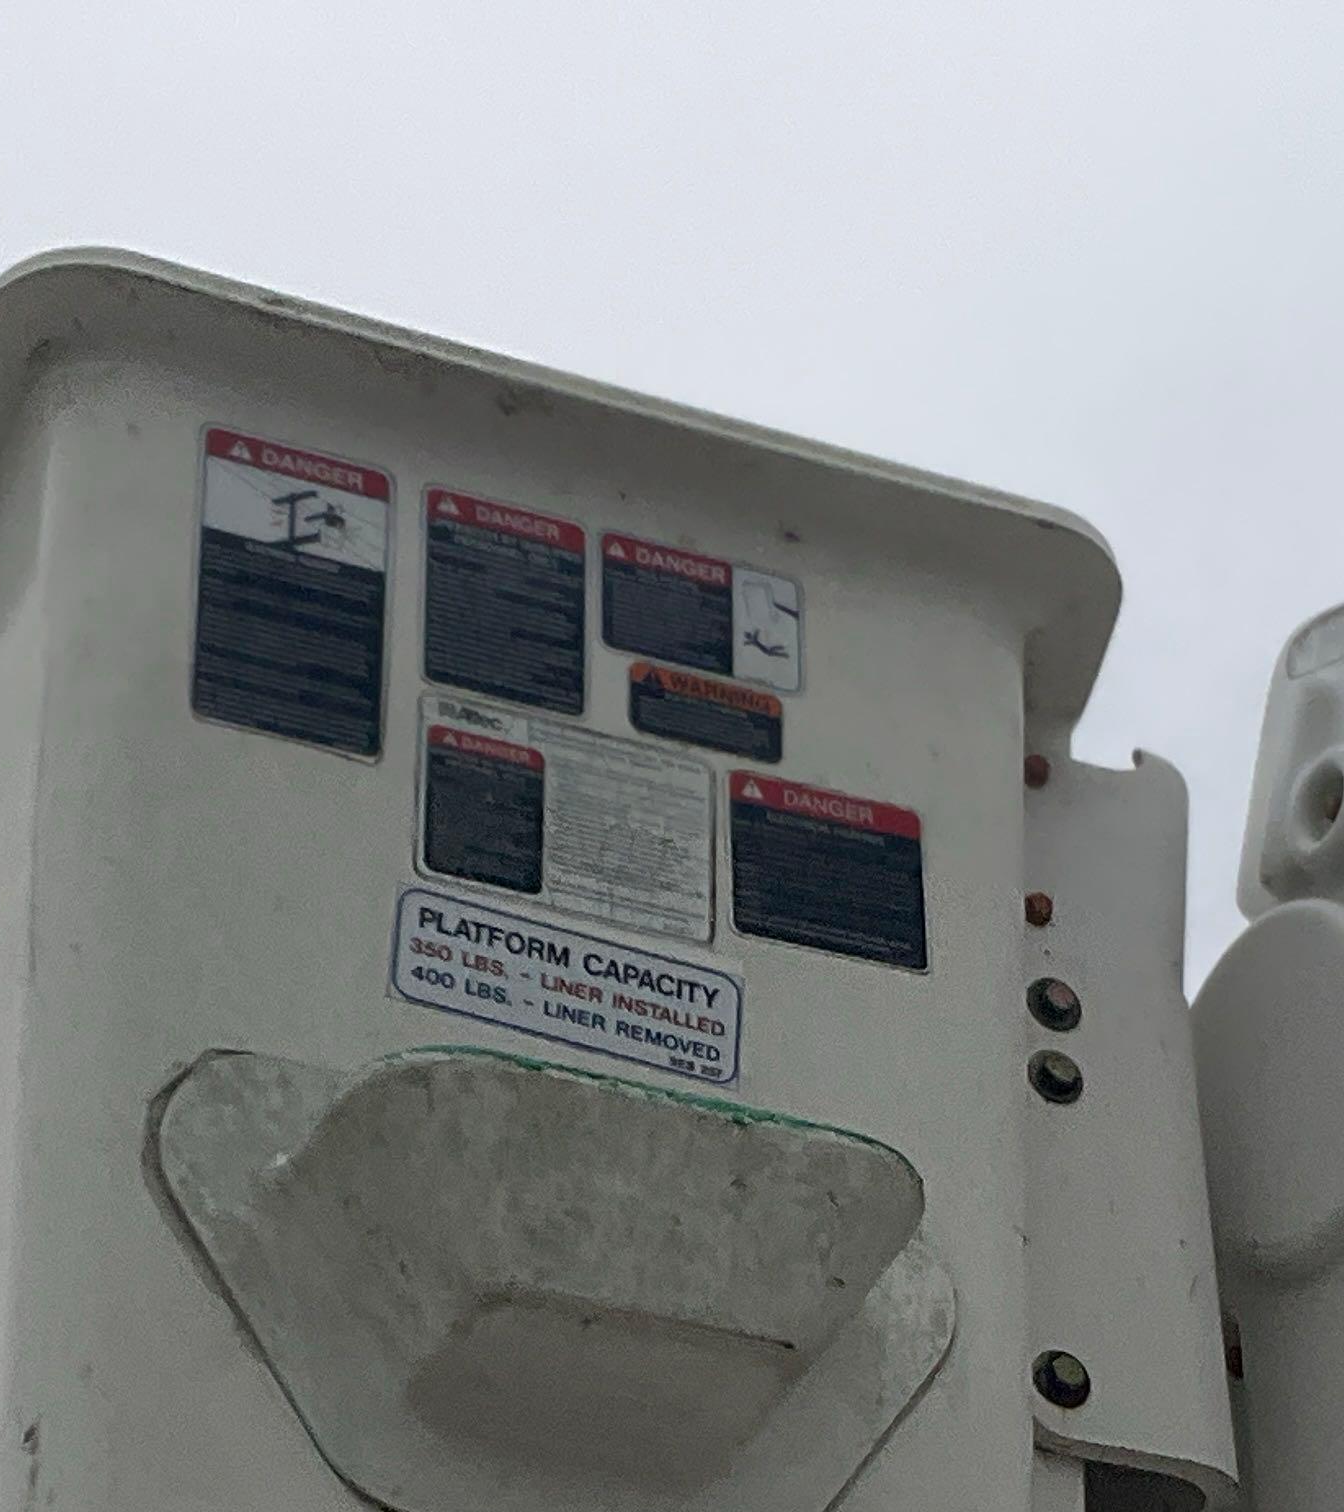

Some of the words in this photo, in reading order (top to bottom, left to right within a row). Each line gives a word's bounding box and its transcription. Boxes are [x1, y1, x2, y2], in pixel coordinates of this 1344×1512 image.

[260, 447, 364, 491] DANGER
[475, 505, 560, 541] DANGER
[635, 547, 726, 584] DANGER
[669, 672, 769, 713] WARNING
[460, 735, 530, 764] DANGER
[783, 789, 874, 825] DANGER
[419, 907, 570, 968] PLATFORM
[583, 953, 720, 1008] CAPACITY
[409, 937, 453, 962] 350
[461, 951, 508, 980] LBS.
[540, 972, 603, 1003] LINER
[612, 992, 725, 1037] INSTALLED
[410, 966, 455, 989] 400
[465, 978, 512, 1006] LBS.
[544, 1000, 606, 1031] LINER
[616, 1020, 720, 1062] REMOVED
